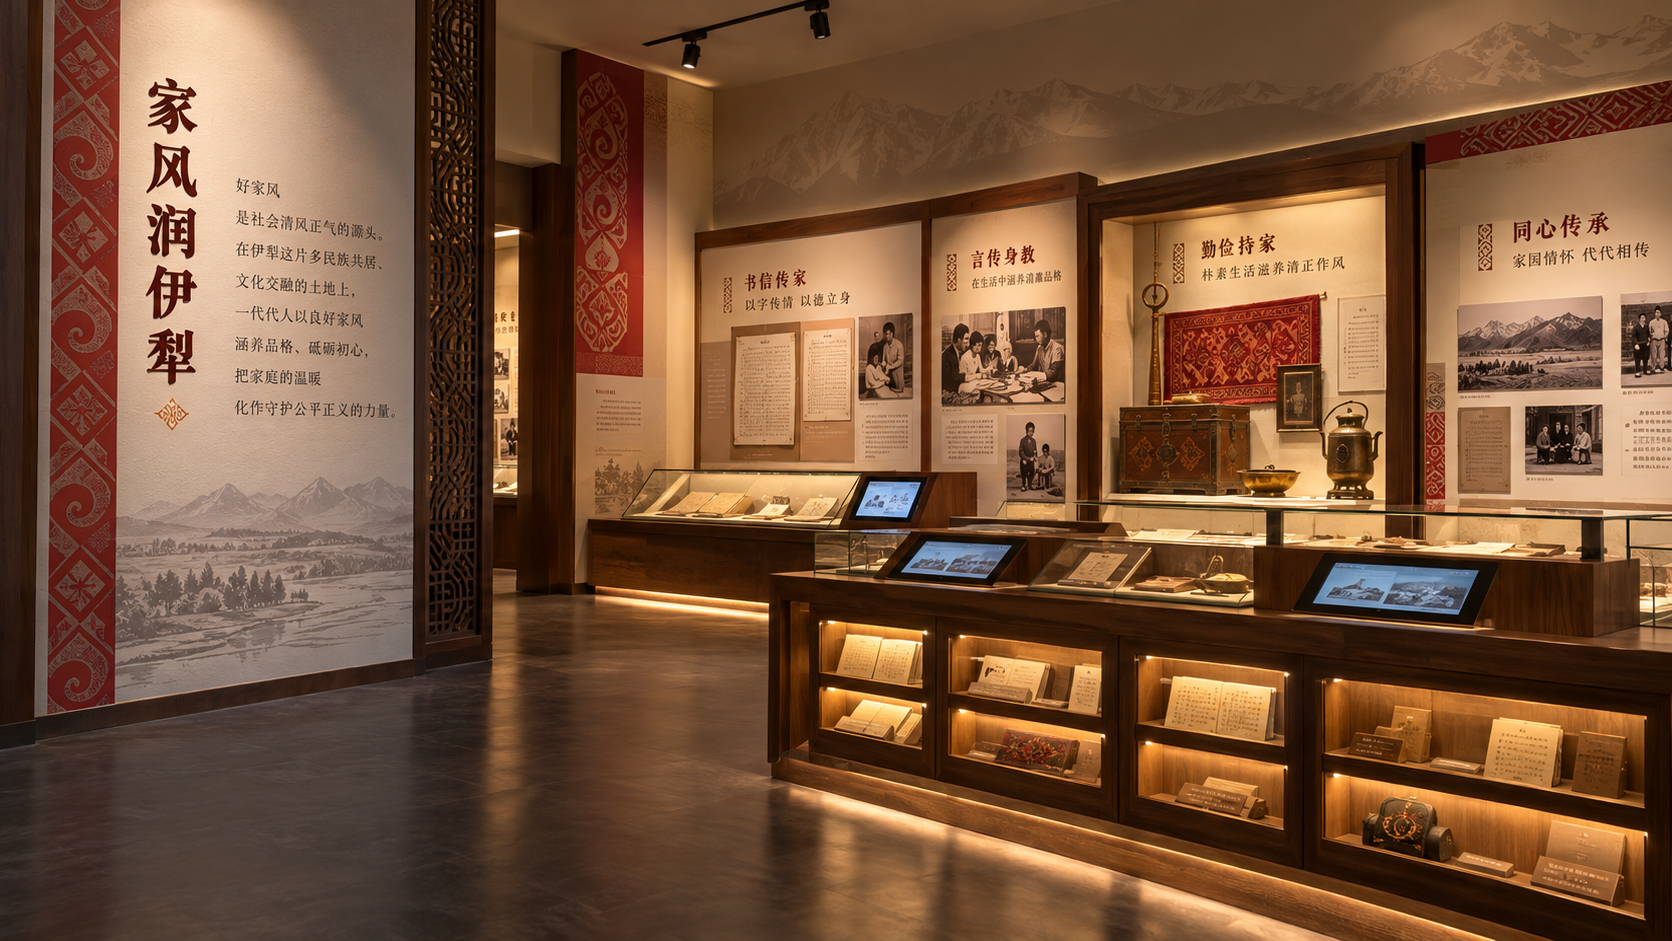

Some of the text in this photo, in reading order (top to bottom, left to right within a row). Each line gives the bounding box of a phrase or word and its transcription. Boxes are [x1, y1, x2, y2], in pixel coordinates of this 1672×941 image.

[236, 178, 280, 198] 好家风
[146, 78, 198, 385] 家风润伊犁
[236, 210, 382, 241] 是社会清风正气的源头。
[1514, 211, 1610, 243] 同心传承
[236, 241, 382, 270] 在伊犁这片多民族共居、
[971, 245, 1035, 269] 言传身教
[1201, 233, 1275, 259] 勤俭持家
[1513, 242, 1649, 268] 家国情怀 代代相传
[236, 273, 354, 298] 文化交融的土地上，
[744, 269, 806, 292] 书信传家
[746, 291, 850, 311] 以字传情 以德立身
[236, 306, 363, 328] 一代代人以良好家风
[235, 336, 368, 358] 涵养品格、砥砺初心，
[235, 368, 321, 386] 把家庭的温暖
[235, 400, 395, 418] 化作守护公平正义的力量。
